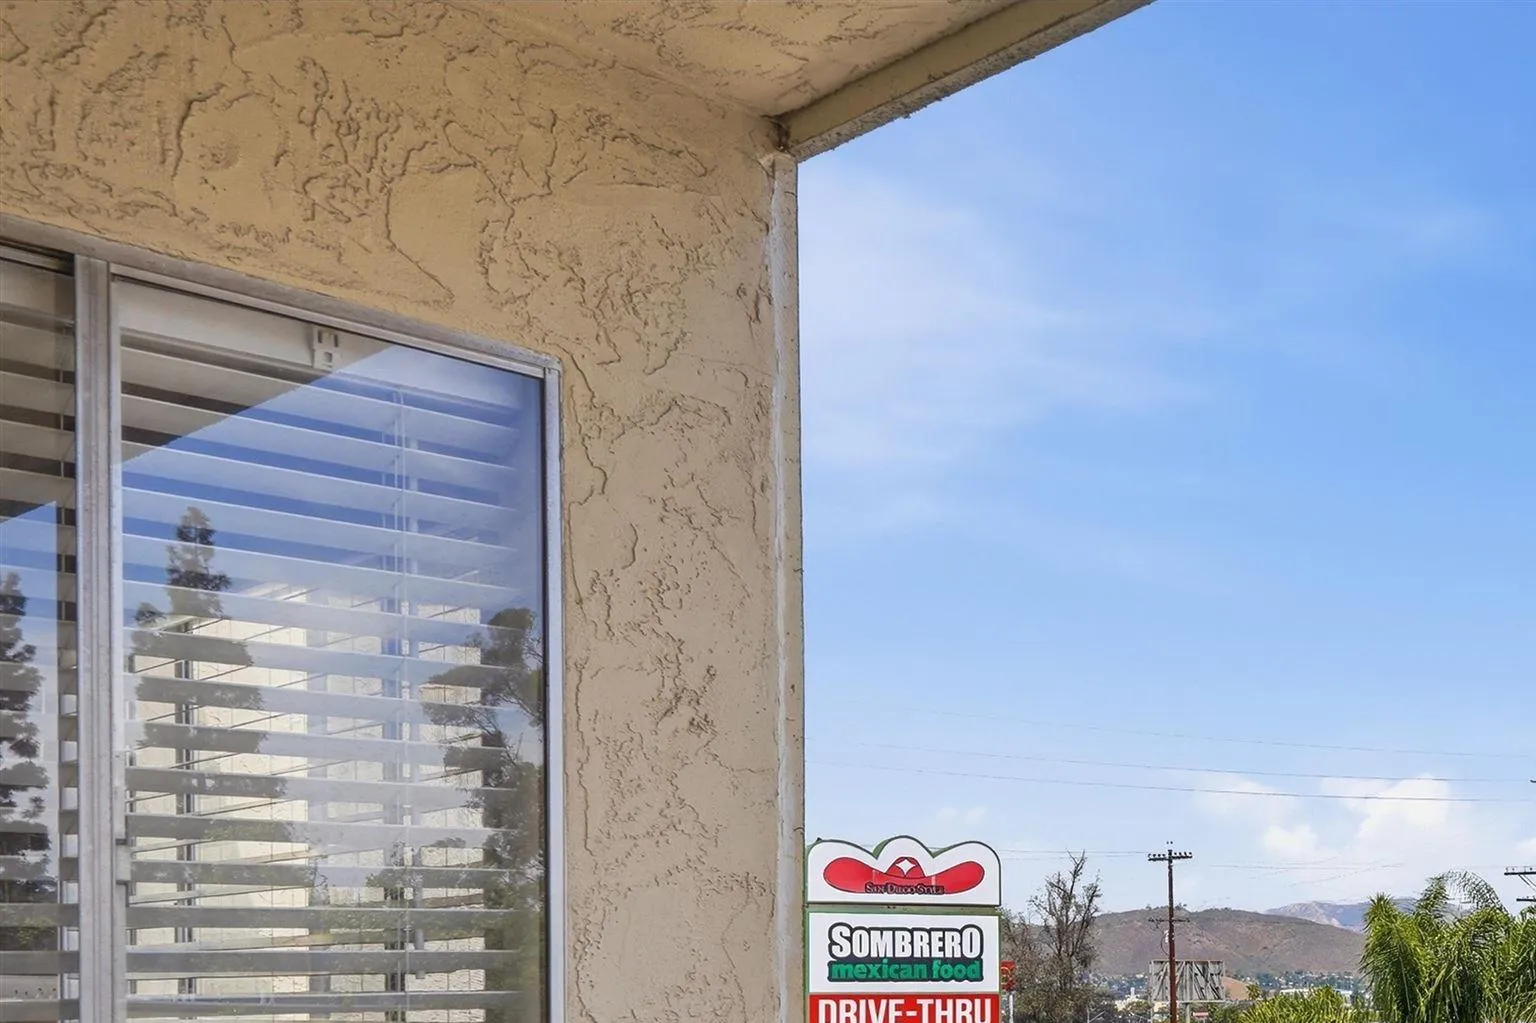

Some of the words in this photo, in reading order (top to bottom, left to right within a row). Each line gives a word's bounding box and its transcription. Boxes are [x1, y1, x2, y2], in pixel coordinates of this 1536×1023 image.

[831, 924, 982, 958] SOMBRERO
[831, 958, 928, 979] mexican
[931, 959, 981, 979] food
